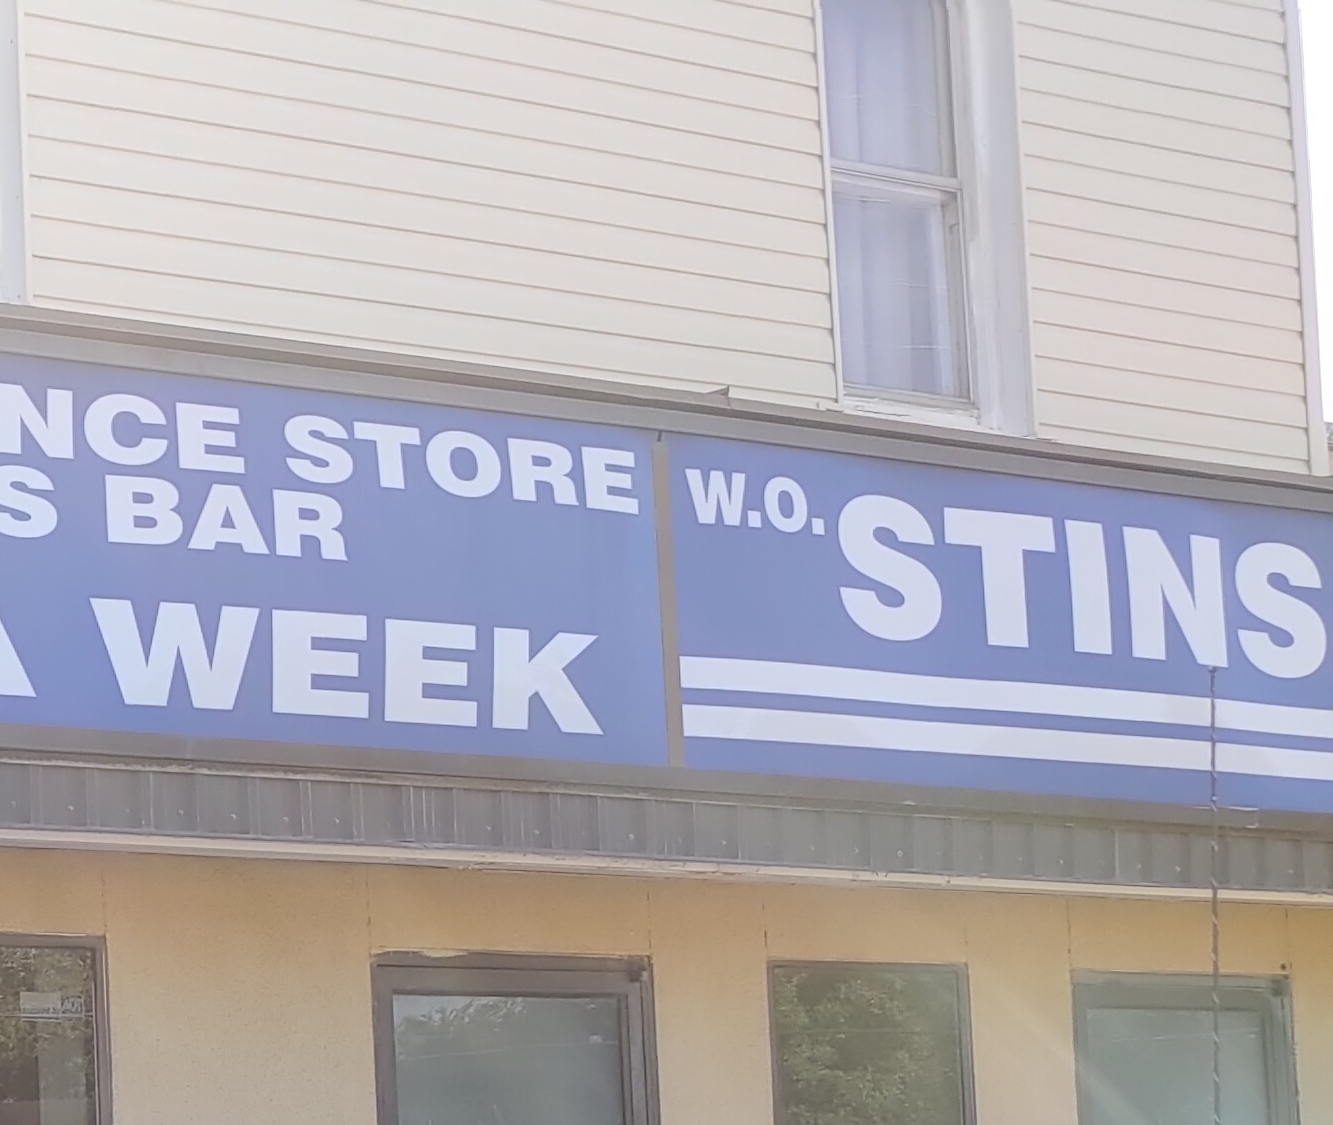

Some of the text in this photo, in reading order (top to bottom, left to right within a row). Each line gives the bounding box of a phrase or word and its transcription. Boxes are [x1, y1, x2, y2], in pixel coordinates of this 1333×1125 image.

[104, 474, 348, 560] BAR
[284, 415, 639, 513] STORE
[685, 469, 1326, 678] W.O. STINS
[90, 598, 603, 735] WEEK
